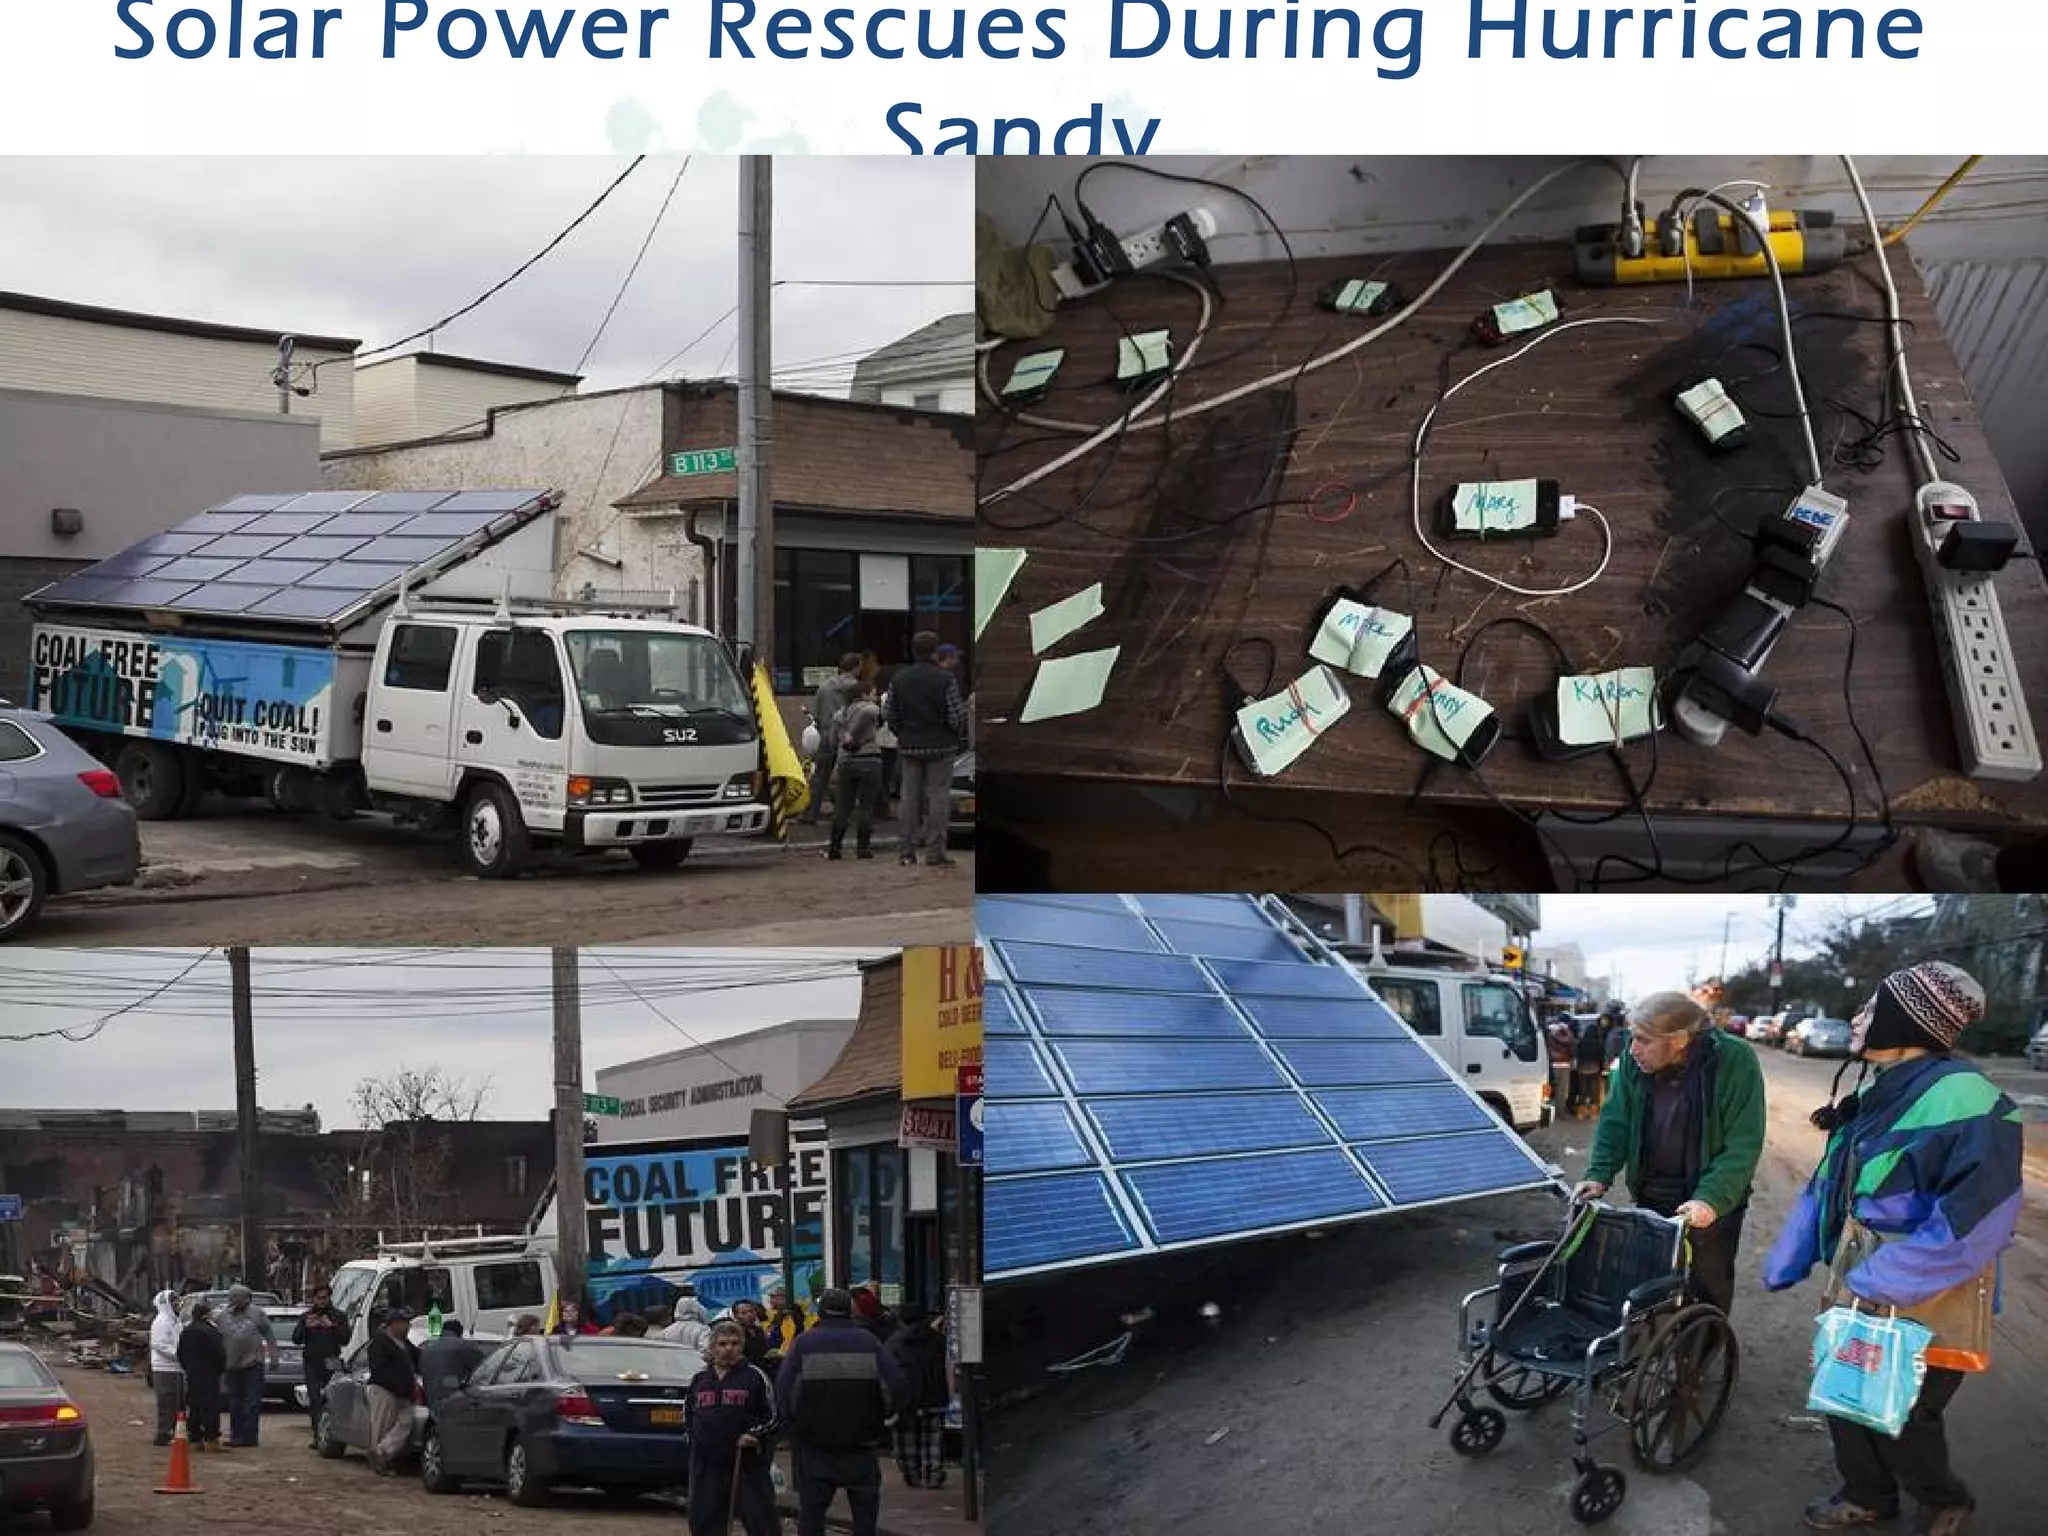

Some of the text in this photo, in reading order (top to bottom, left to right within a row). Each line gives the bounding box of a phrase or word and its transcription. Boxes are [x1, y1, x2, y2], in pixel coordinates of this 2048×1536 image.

[692, 453, 718, 471] 113
[35, 631, 160, 679] COAL FREE
[32, 666, 156, 728] FUTURE
[254, 699, 319, 736] COAL!
[264, 730, 287, 750] THE
[290, 735, 317, 754] SUN
[690, 1073, 763, 1107] ADMINISTRATION
[584, 1149, 827, 1206] COAL FREE
[587, 1191, 826, 1264] FUTURE
